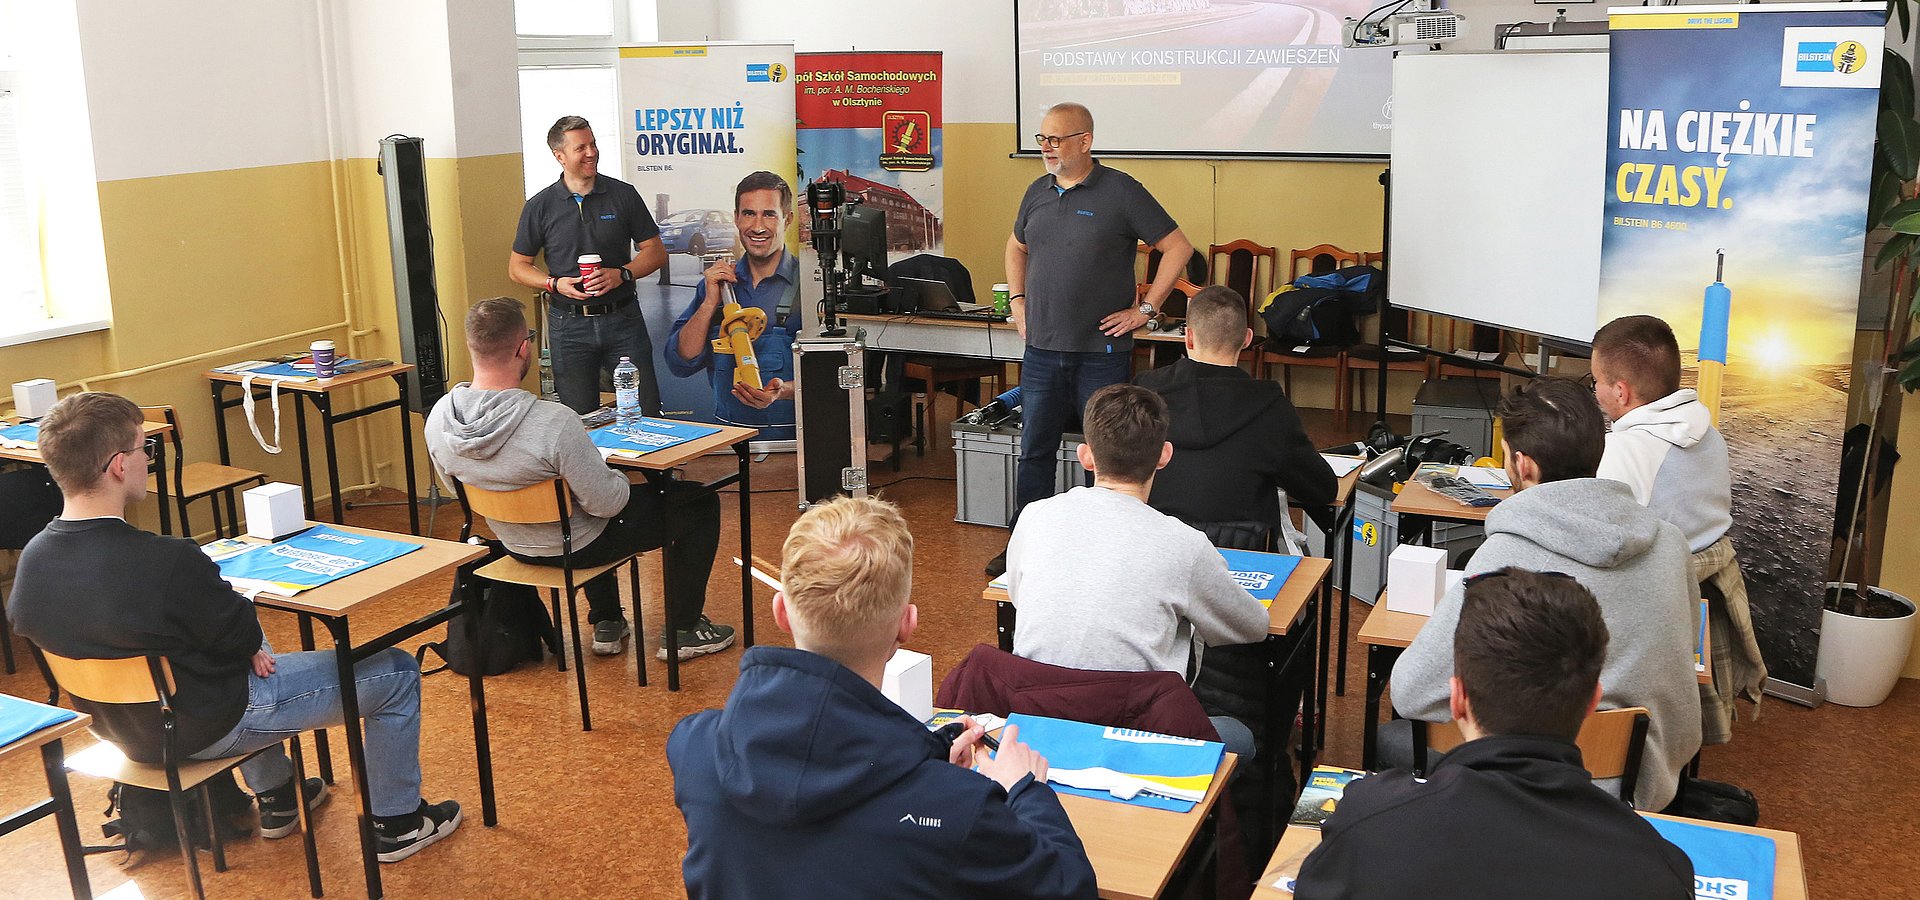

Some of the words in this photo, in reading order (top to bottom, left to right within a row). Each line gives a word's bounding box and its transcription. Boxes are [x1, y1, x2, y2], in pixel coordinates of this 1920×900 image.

[1043, 51, 1127, 66] PODSTAWY
[1131, 50, 1241, 65] KONSTRUKCJI
[1245, 45, 1340, 64] ZAWIESZEŃ
[1797, 52, 1832, 62] BILSTEIN
[795, 71, 813, 84] pół
[815, 70, 844, 81] Szkół
[847, 70, 937, 83] Samochodowych
[842, 97, 883, 107] Olsztynie
[635, 107, 706, 131] LEPSZY
[711, 101, 745, 130] NIŻ
[1618, 109, 1668, 152] NA
[1675, 99, 1817, 167] CIĘŻKIE
[636, 132, 745, 156] ORYGINAŁ.
[637, 164, 663, 172] BILSTEIN
[1615, 162, 1734, 211] CZASY.
[1613, 216, 1649, 229] BILSTEIN
